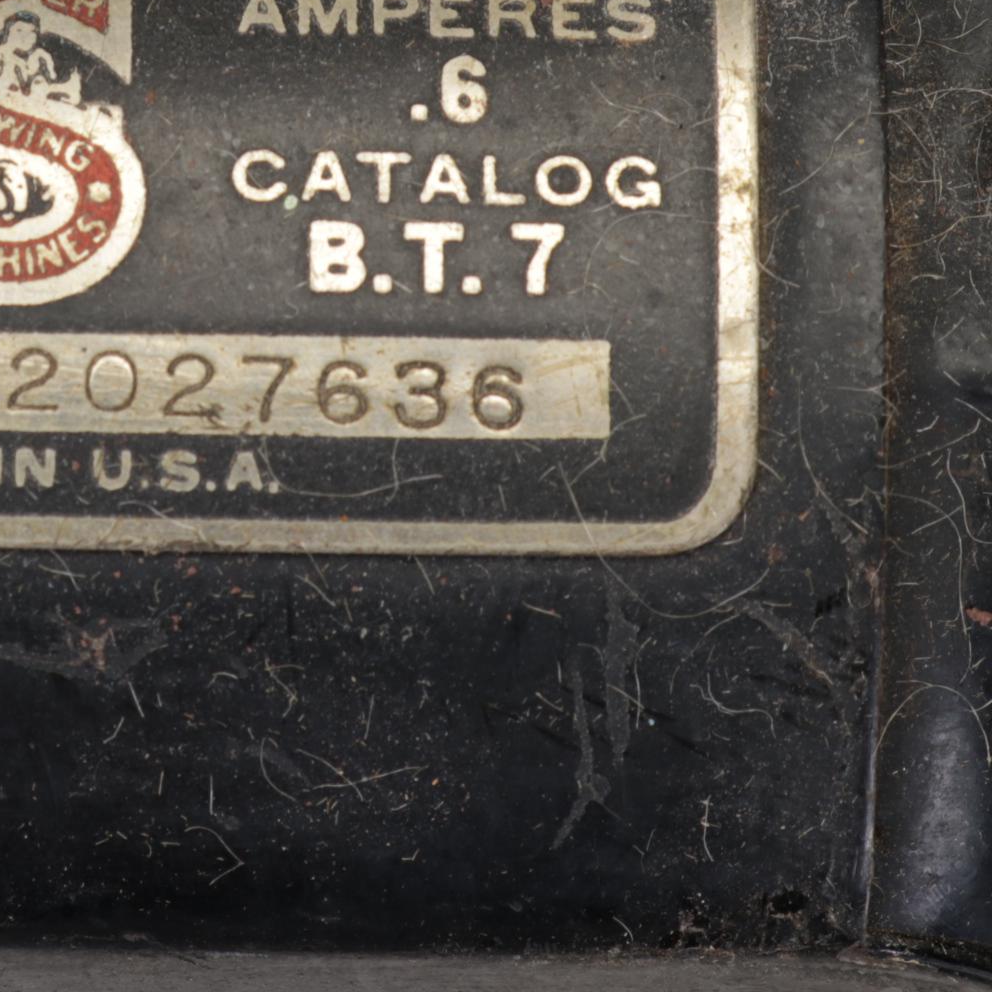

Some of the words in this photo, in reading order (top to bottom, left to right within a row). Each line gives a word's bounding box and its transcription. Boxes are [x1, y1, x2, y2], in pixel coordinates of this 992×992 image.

[409, 54, 488, 123] .6
[231, 149, 662, 208] CATALOG
[309, 219, 483, 295] B.T.
[6, 345, 525, 431] 2027636
[93, 449, 280, 495] U.S.A.
